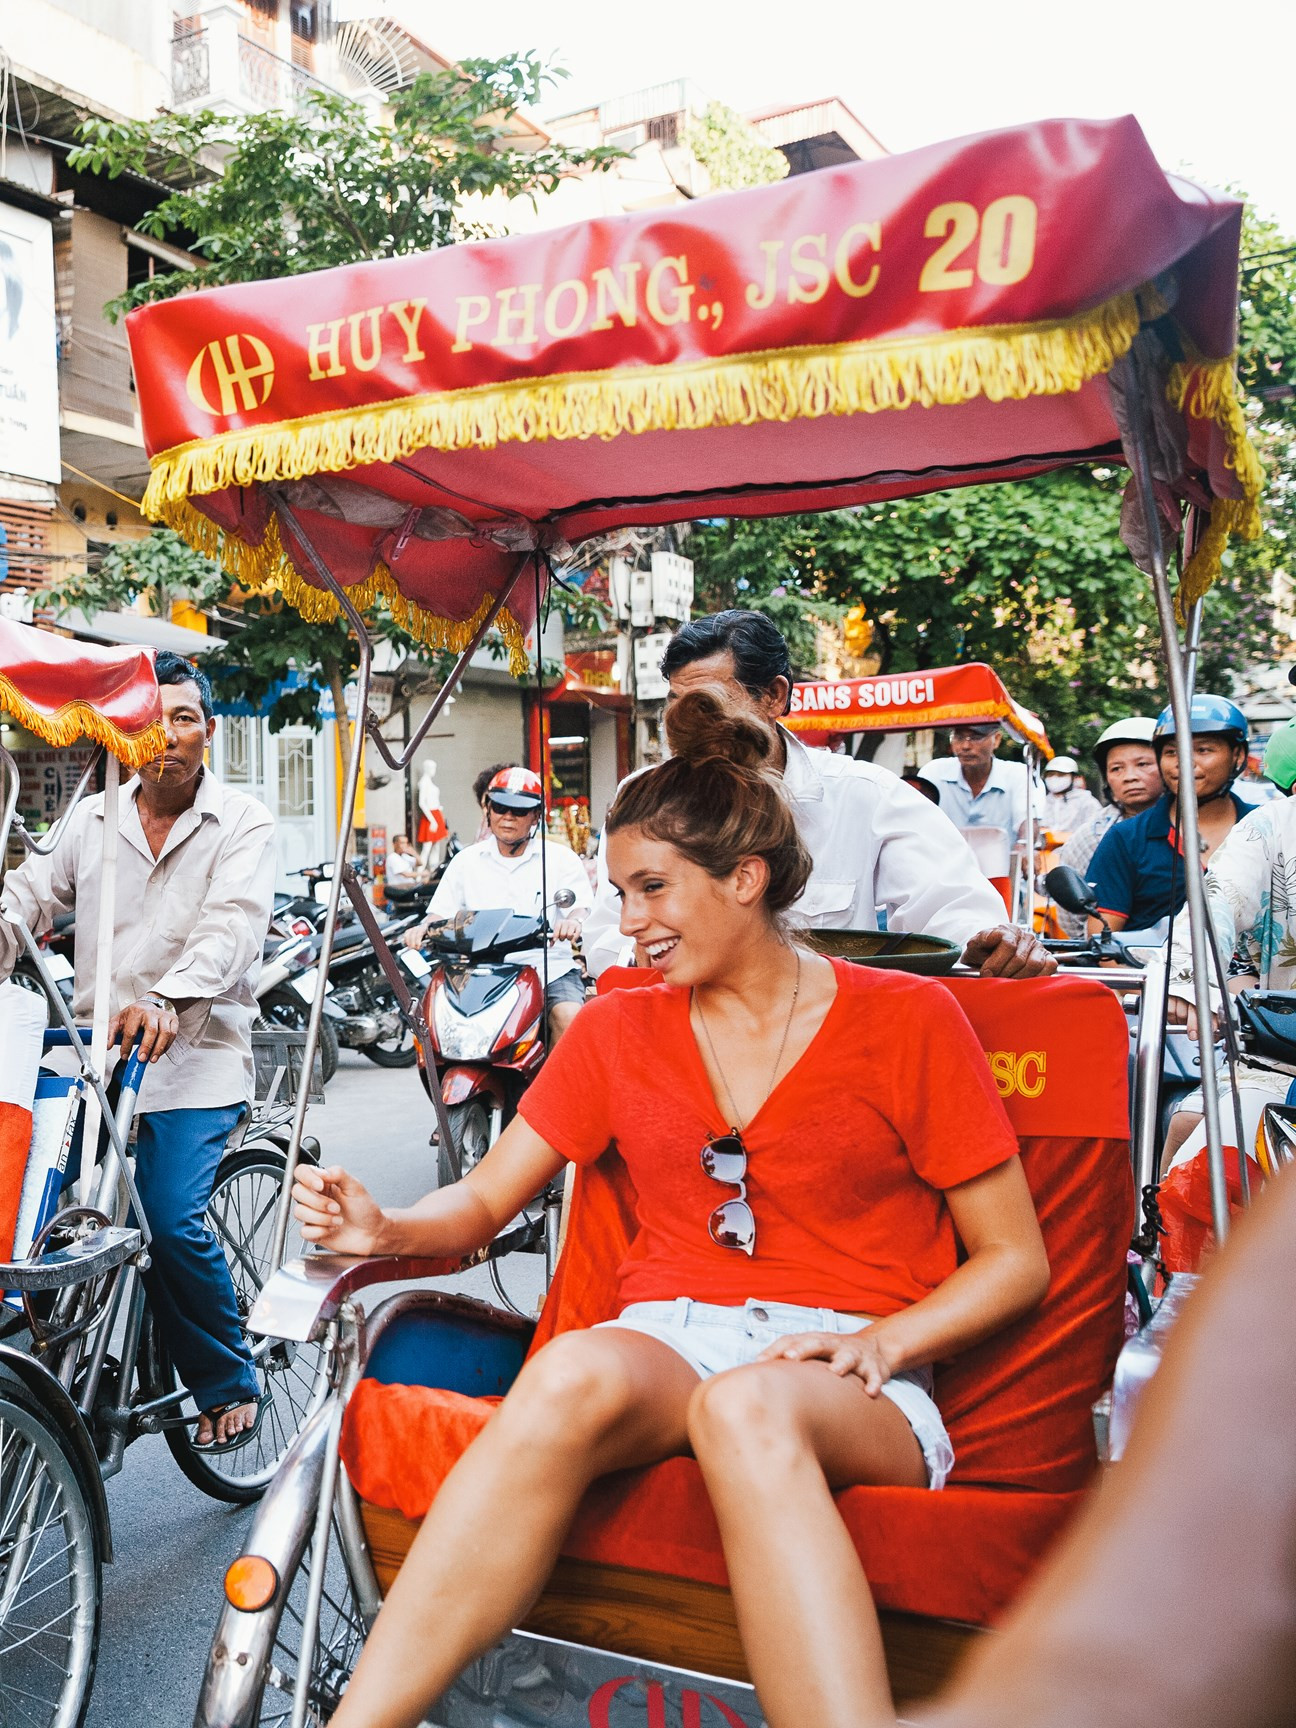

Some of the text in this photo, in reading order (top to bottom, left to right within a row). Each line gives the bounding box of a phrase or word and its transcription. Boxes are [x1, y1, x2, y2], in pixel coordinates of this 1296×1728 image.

[306, 298, 428, 381] HUY
[745, 221, 882, 310] JSC
[919, 195, 1038, 293] 20
[790, 678, 935, 712] SANS SOUCI
[984, 1051, 1047, 1098] SC
